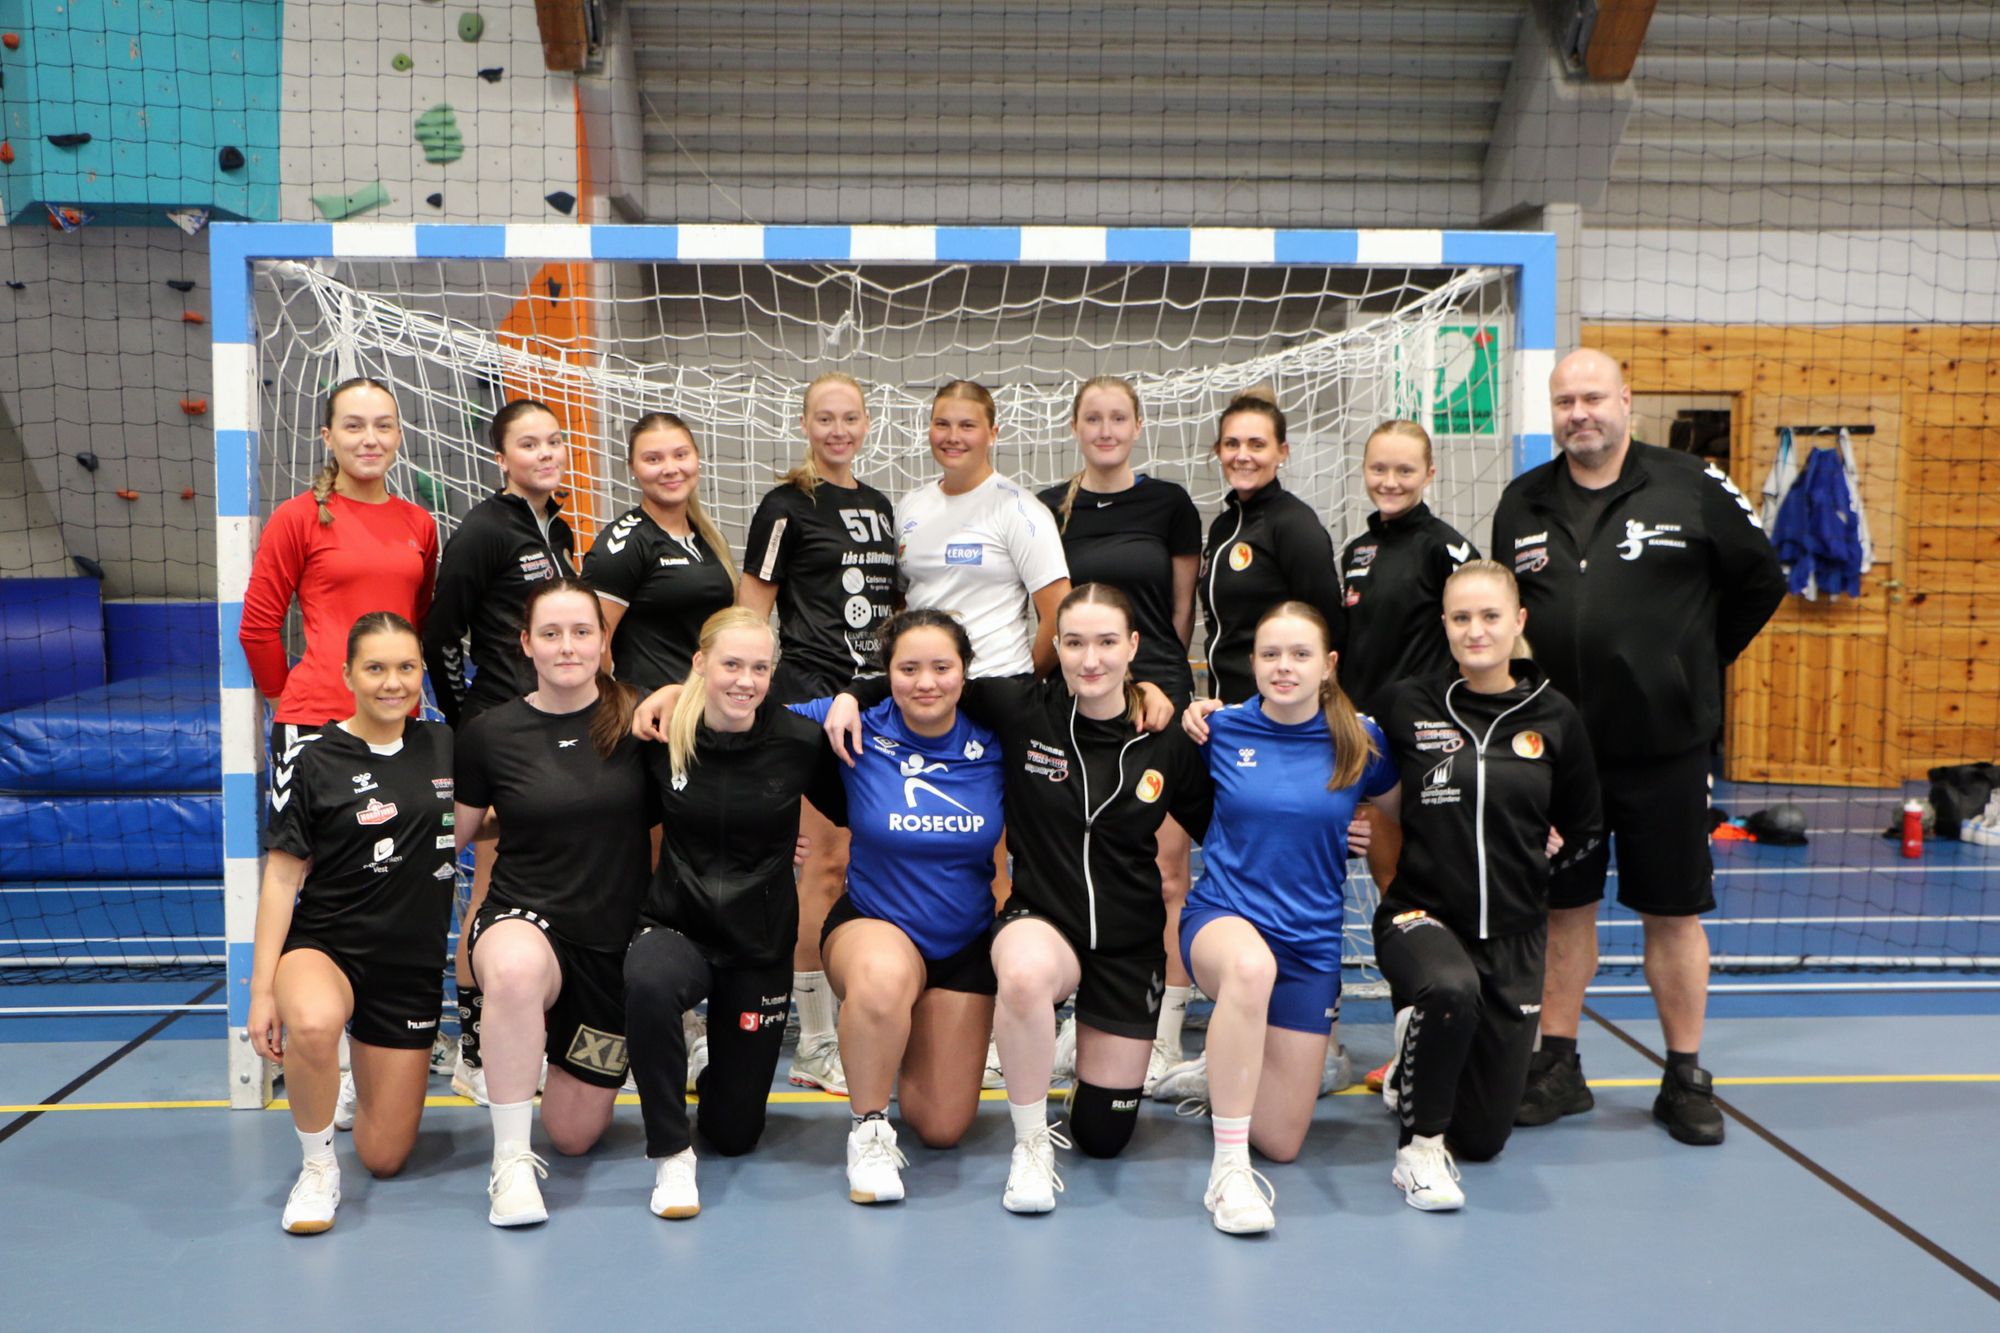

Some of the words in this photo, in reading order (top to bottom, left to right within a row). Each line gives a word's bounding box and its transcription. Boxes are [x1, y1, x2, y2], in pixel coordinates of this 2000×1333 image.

[839, 508, 882, 543] 57
[947, 548, 979, 559] LERØY
[889, 813, 985, 832] ROSECUP
